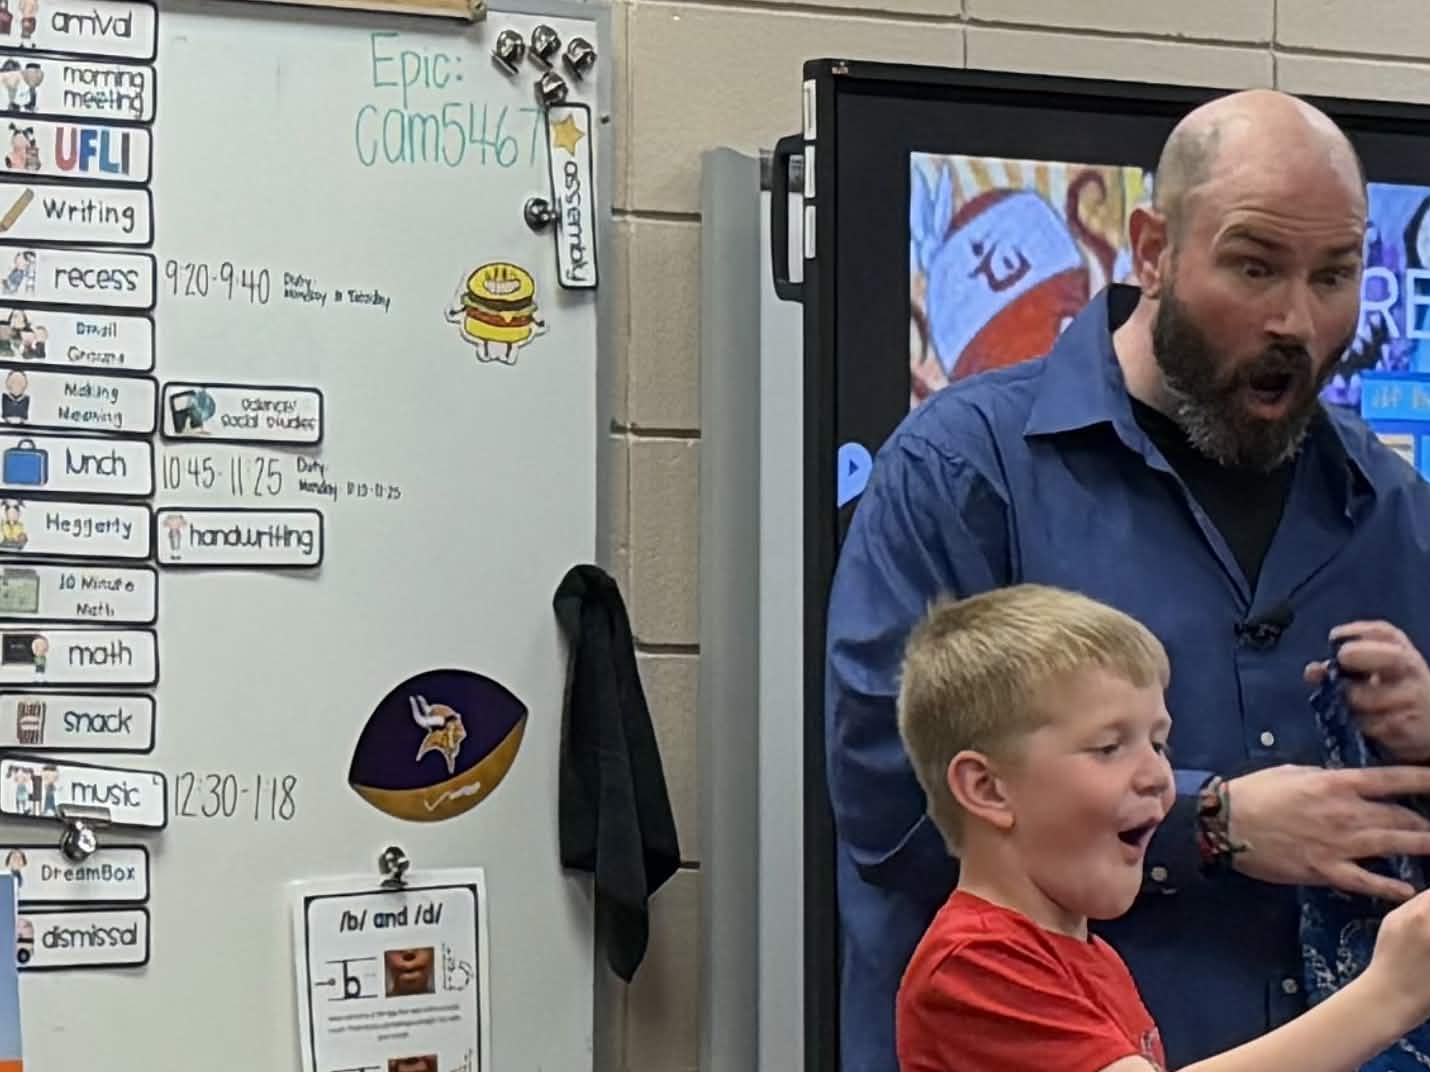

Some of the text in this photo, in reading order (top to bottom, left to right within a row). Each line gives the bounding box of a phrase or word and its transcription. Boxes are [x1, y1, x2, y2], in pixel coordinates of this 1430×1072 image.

[51, 9, 133, 39] arrival
[63, 66, 146, 93] morning
[63, 89, 145, 120] meeting
[55, 126, 131, 176] UFLI
[42, 198, 136, 234] Writing
[54, 266, 140, 292] recess
[65, 447, 128, 478] lunch
[45, 511, 133, 541] Heggerty
[189, 523, 314, 555] handwriting
[67, 639, 134, 667] math
[62, 706, 134, 735] snack
[71, 780, 142, 808] music
[41, 863, 136, 882] DreamBox
[372, 906, 409, 930] and
[41, 921, 138, 949] dismissal
